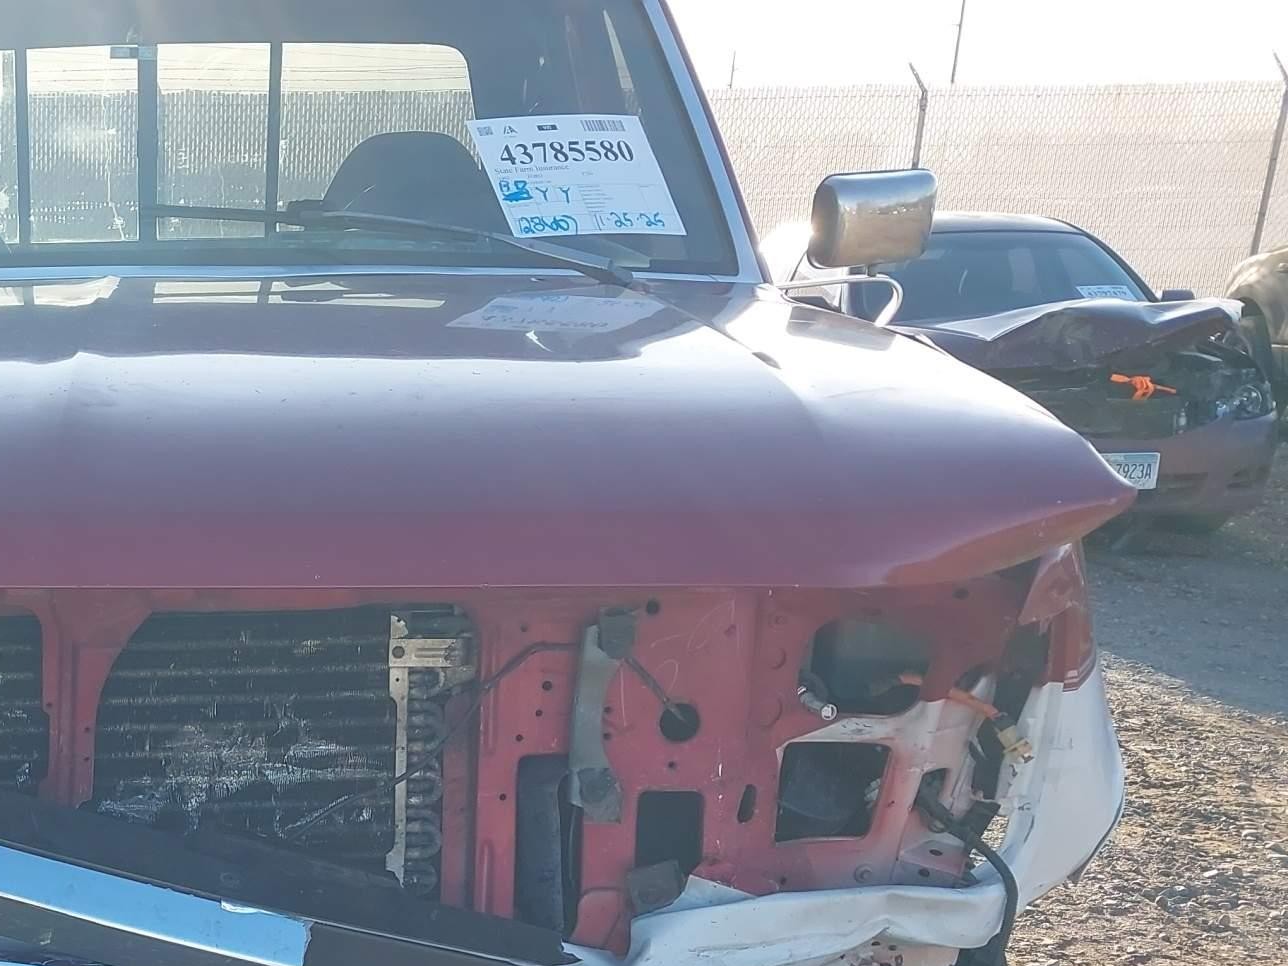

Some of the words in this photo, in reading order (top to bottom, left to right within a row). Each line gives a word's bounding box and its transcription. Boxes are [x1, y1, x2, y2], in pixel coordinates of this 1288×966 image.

[500, 139, 634, 165] 43785580
[494, 167, 513, 175] State
[514, 166, 534, 174] Farm
[535, 164, 571, 173] Insurance
[1110, 463, 1152, 480] 7923A
